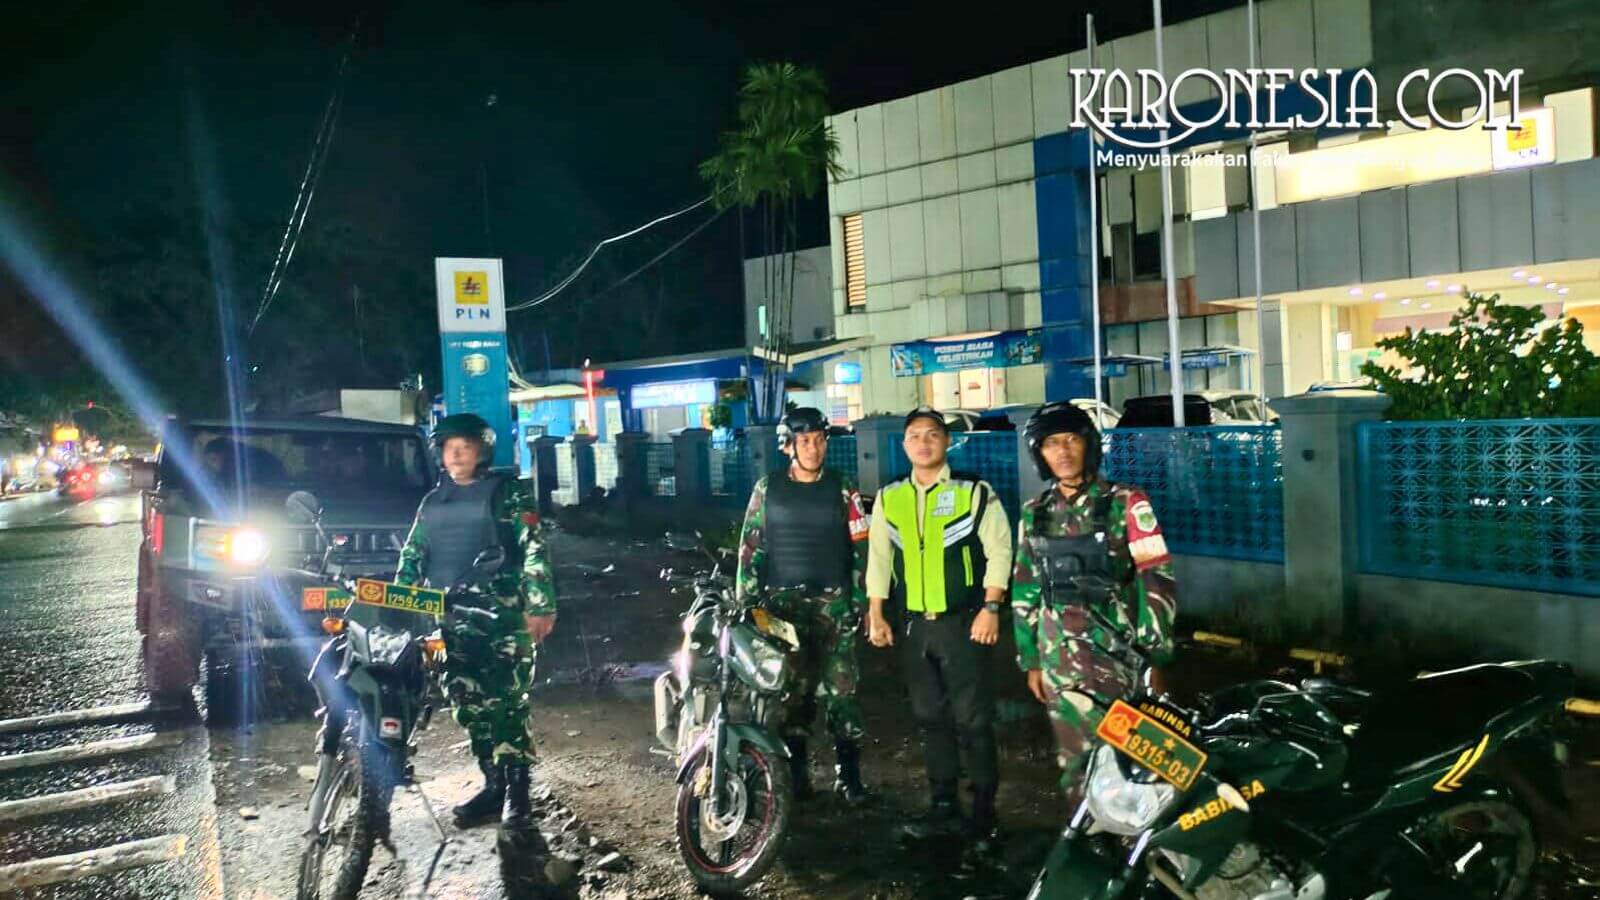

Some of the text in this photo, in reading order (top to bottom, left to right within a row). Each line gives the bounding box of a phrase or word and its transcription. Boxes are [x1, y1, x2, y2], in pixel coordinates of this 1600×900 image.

[455, 308, 490, 320] PLN
[1139, 702, 1192, 738] BABINSA
[1178, 779, 1265, 831] BABISA
